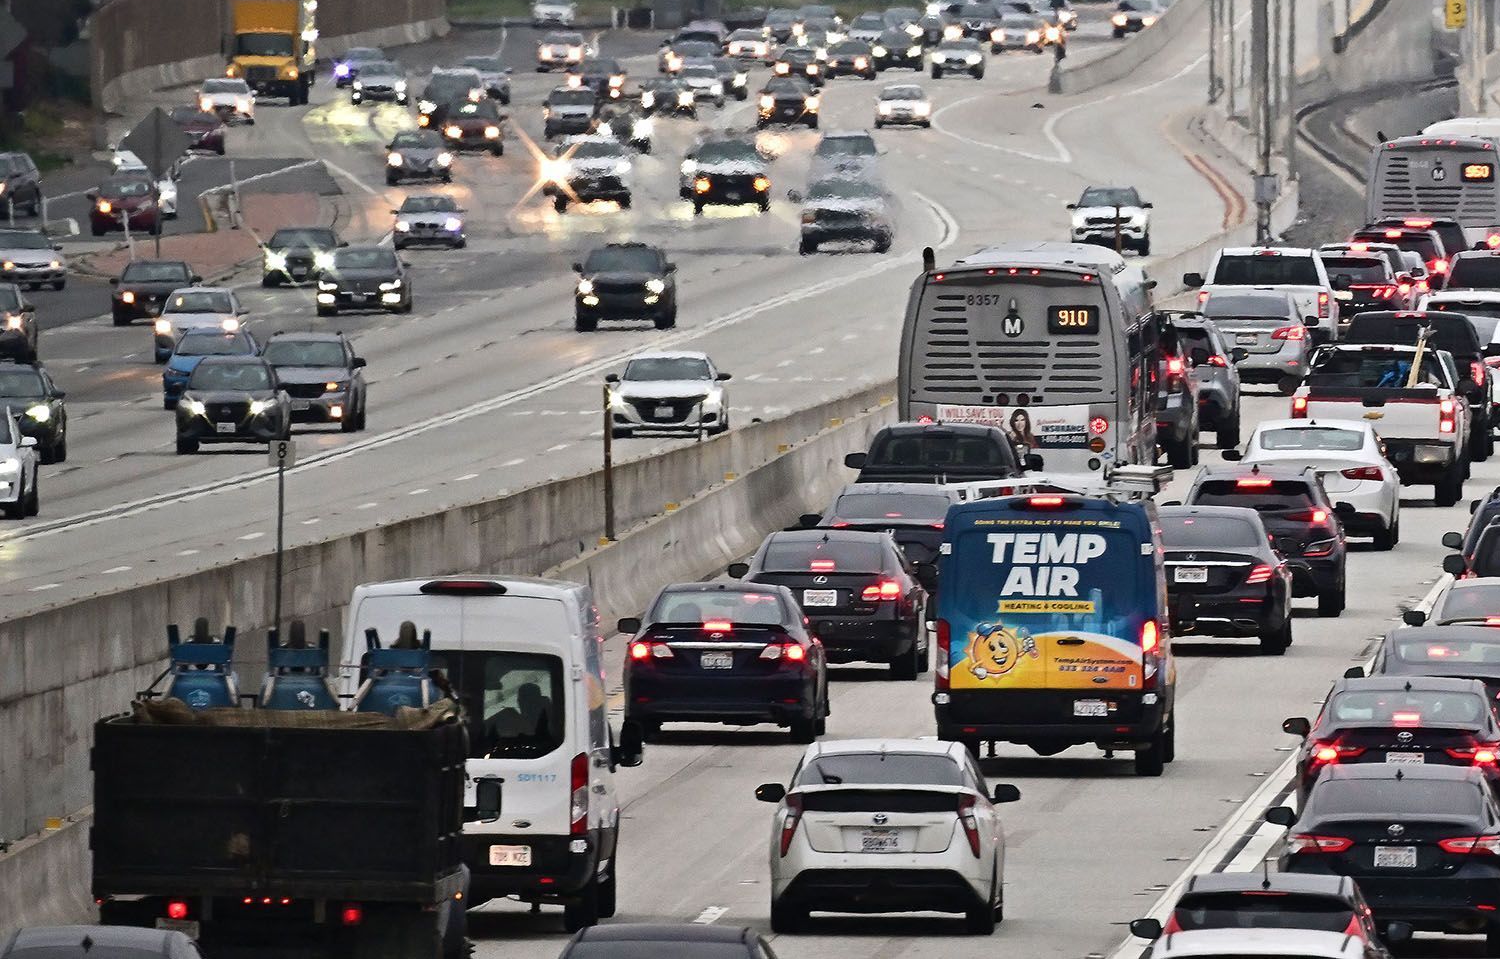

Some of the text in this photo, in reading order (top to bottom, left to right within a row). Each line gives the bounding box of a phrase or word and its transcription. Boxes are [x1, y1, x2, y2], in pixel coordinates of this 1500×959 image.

[966, 294, 1000, 306] 8357
[1058, 309, 1089, 326] 910
[1004, 318, 1021, 334] M
[278, 442, 287, 458] 8
[987, 533, 1107, 564] TEMP
[1000, 566, 1080, 597] AIR
[1052, 603, 1090, 611] COOLING
[517, 773, 557, 782] SDT117
